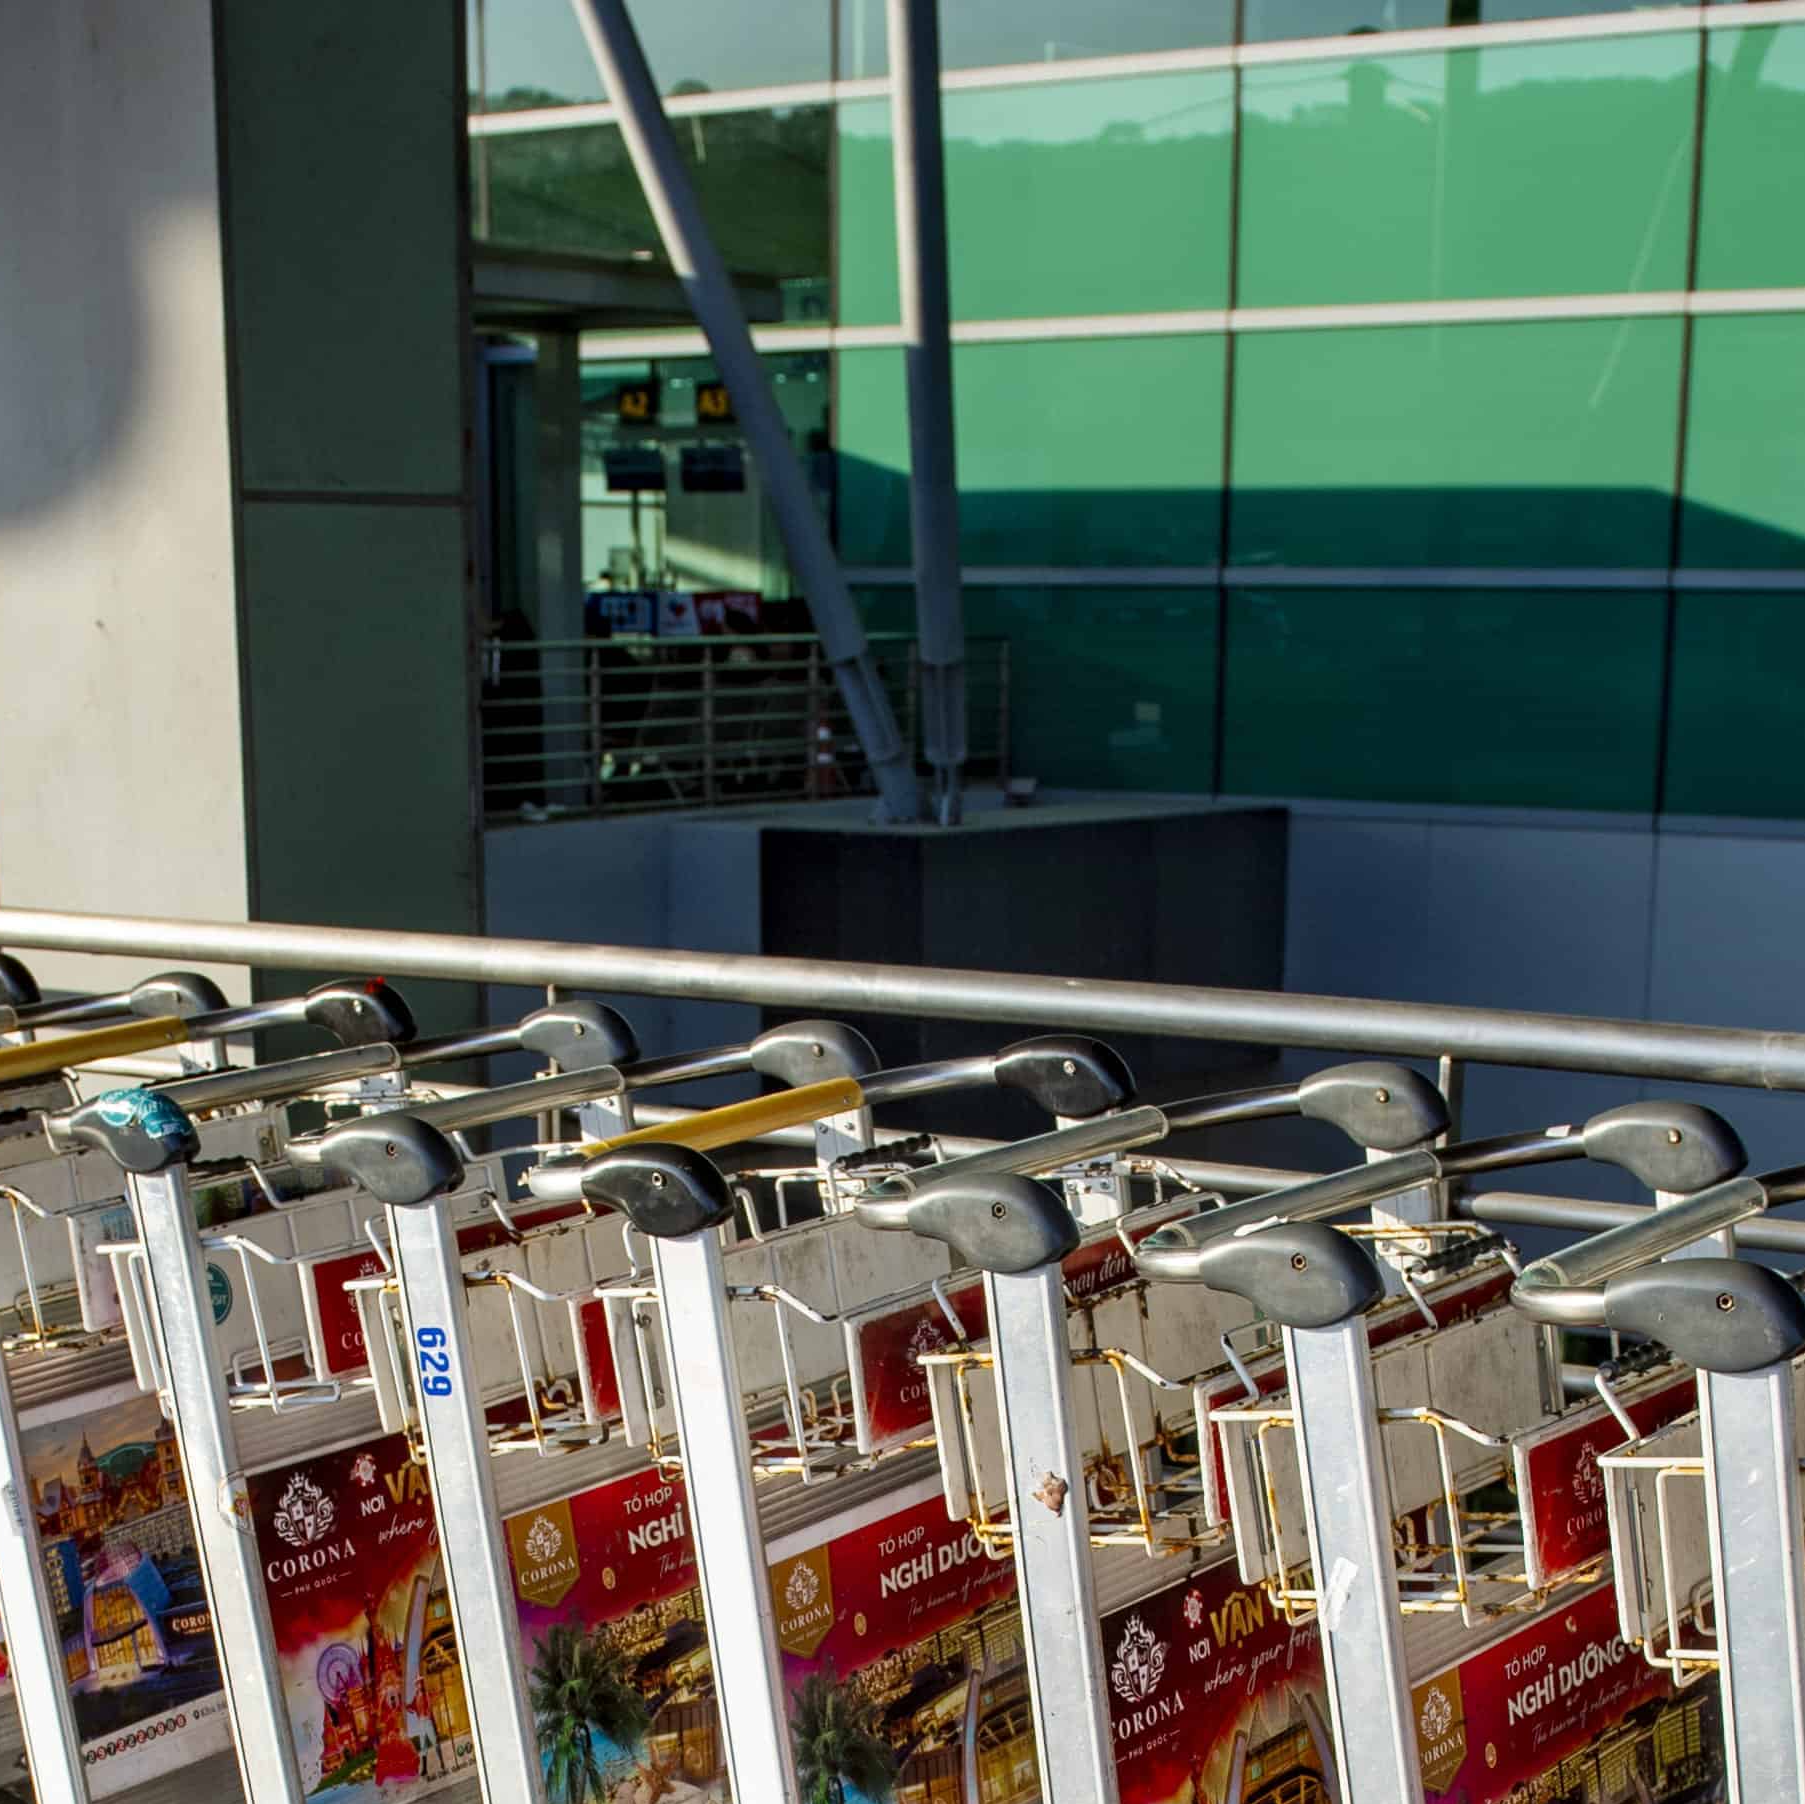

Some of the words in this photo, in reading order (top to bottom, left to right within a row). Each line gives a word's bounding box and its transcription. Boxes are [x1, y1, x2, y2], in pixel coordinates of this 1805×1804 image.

[619, 391, 648, 417] A2
[417, 1327, 452, 1397] 629
[378, 1513, 427, 1545] where
[627, 1502, 686, 1555] NGHỈ
[267, 1537, 357, 1583] CORONA
[520, 1555, 575, 1586] CORONA
[880, 1541, 933, 1600] NGHỈ
[779, 1601, 832, 1636] CORONA
[1208, 1590, 1265, 1648] VẬN
[1204, 1655, 1245, 1695] where
[1245, 1643, 1285, 1695] your
[1506, 1663, 1557, 1727] NGHỈ
[1557, 1633, 1626, 1698] DƯỠNG
[1521, 1643, 1548, 1671] HỢP
